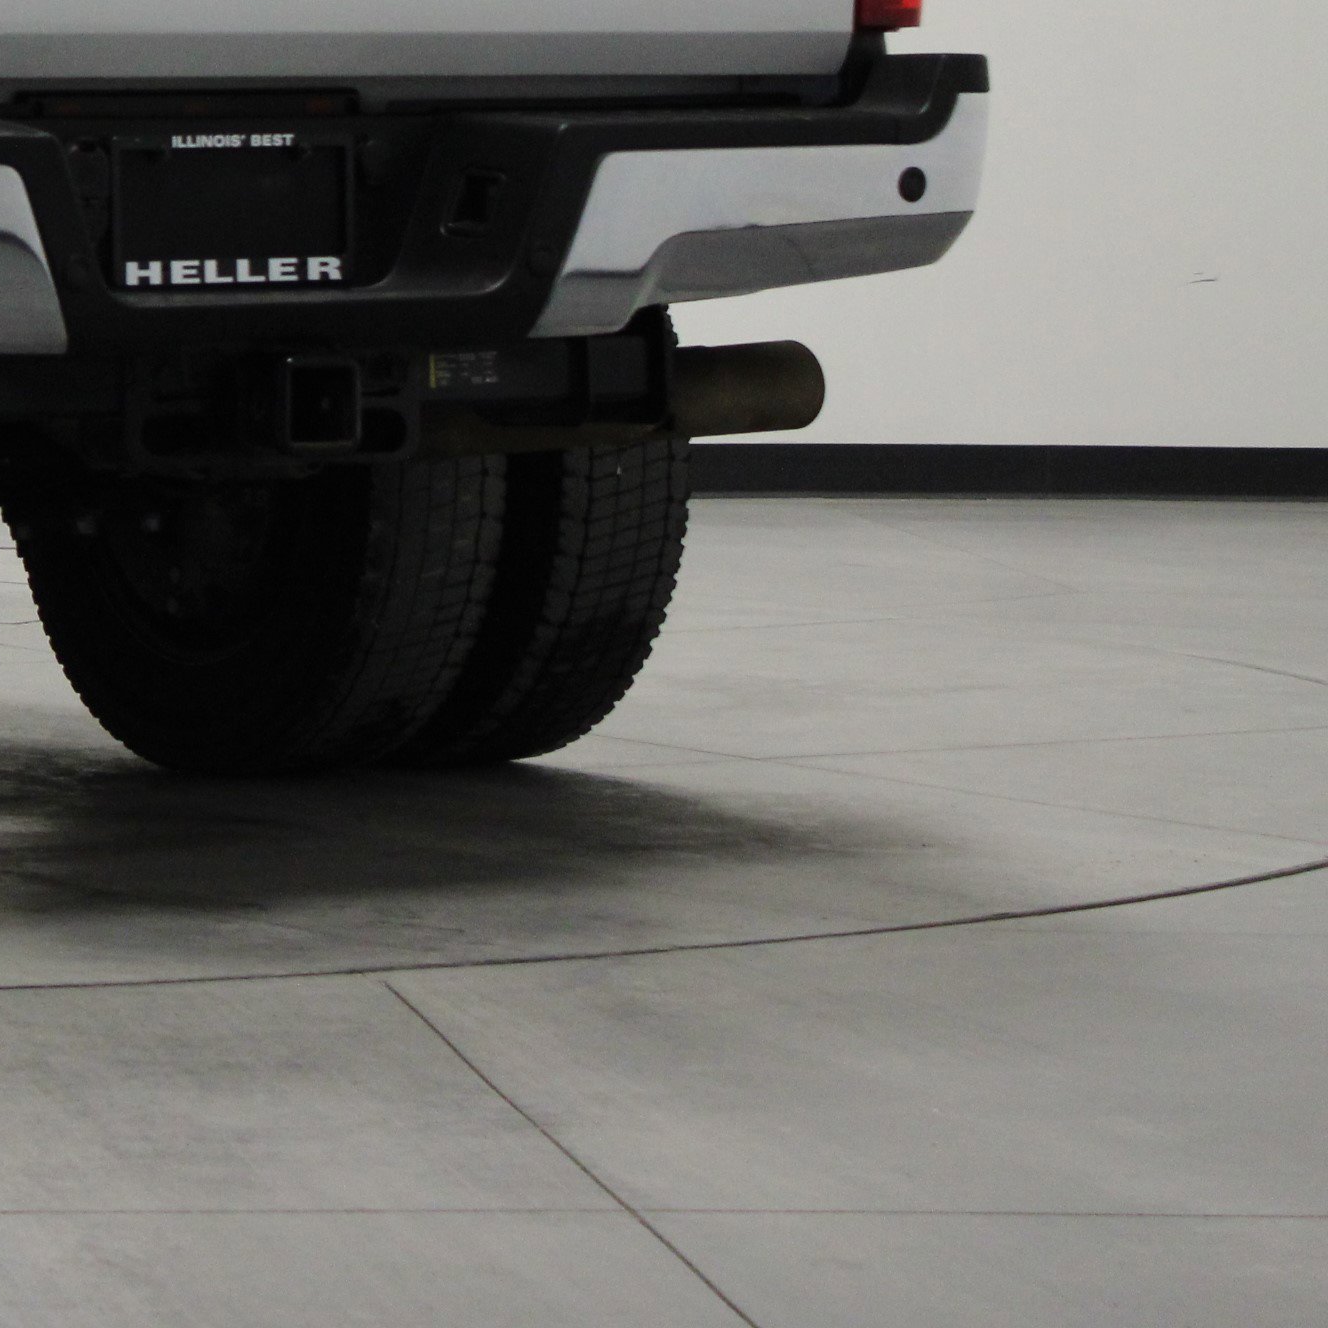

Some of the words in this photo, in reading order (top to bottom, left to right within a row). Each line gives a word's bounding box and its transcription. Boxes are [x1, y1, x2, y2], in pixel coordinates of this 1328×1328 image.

[171, 134, 246, 149] ILLINOIS'
[249, 133, 294, 147] BEST
[125, 255, 343, 286] HELLER
